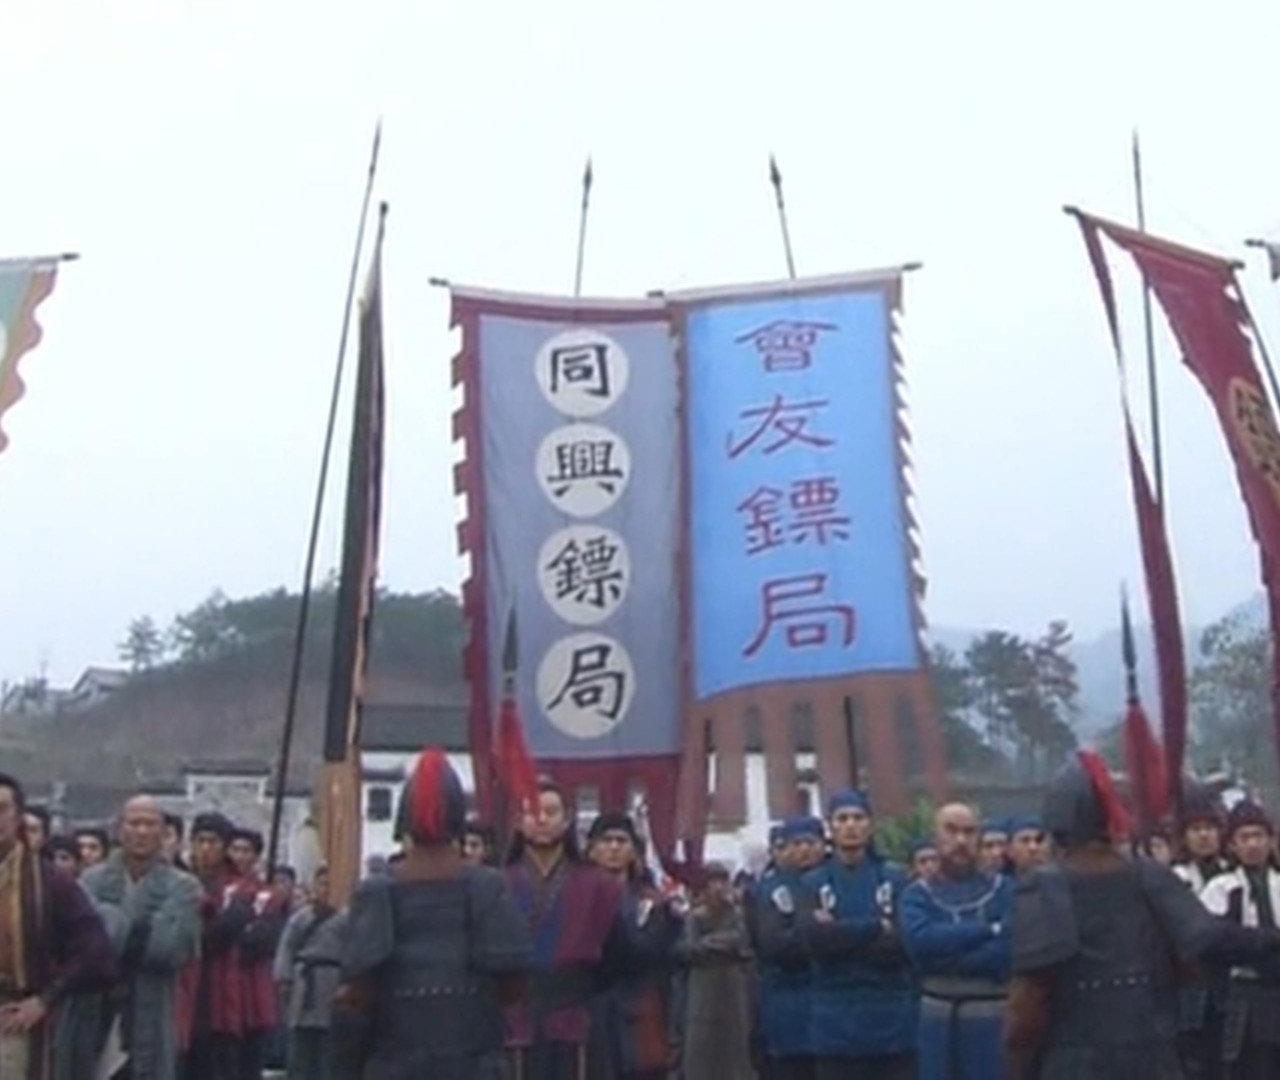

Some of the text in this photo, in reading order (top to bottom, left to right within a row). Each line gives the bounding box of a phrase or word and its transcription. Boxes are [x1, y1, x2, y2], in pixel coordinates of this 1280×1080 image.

[545, 342, 625, 720] 同興鏢局
[726, 318, 857, 660] 會友鏢局
